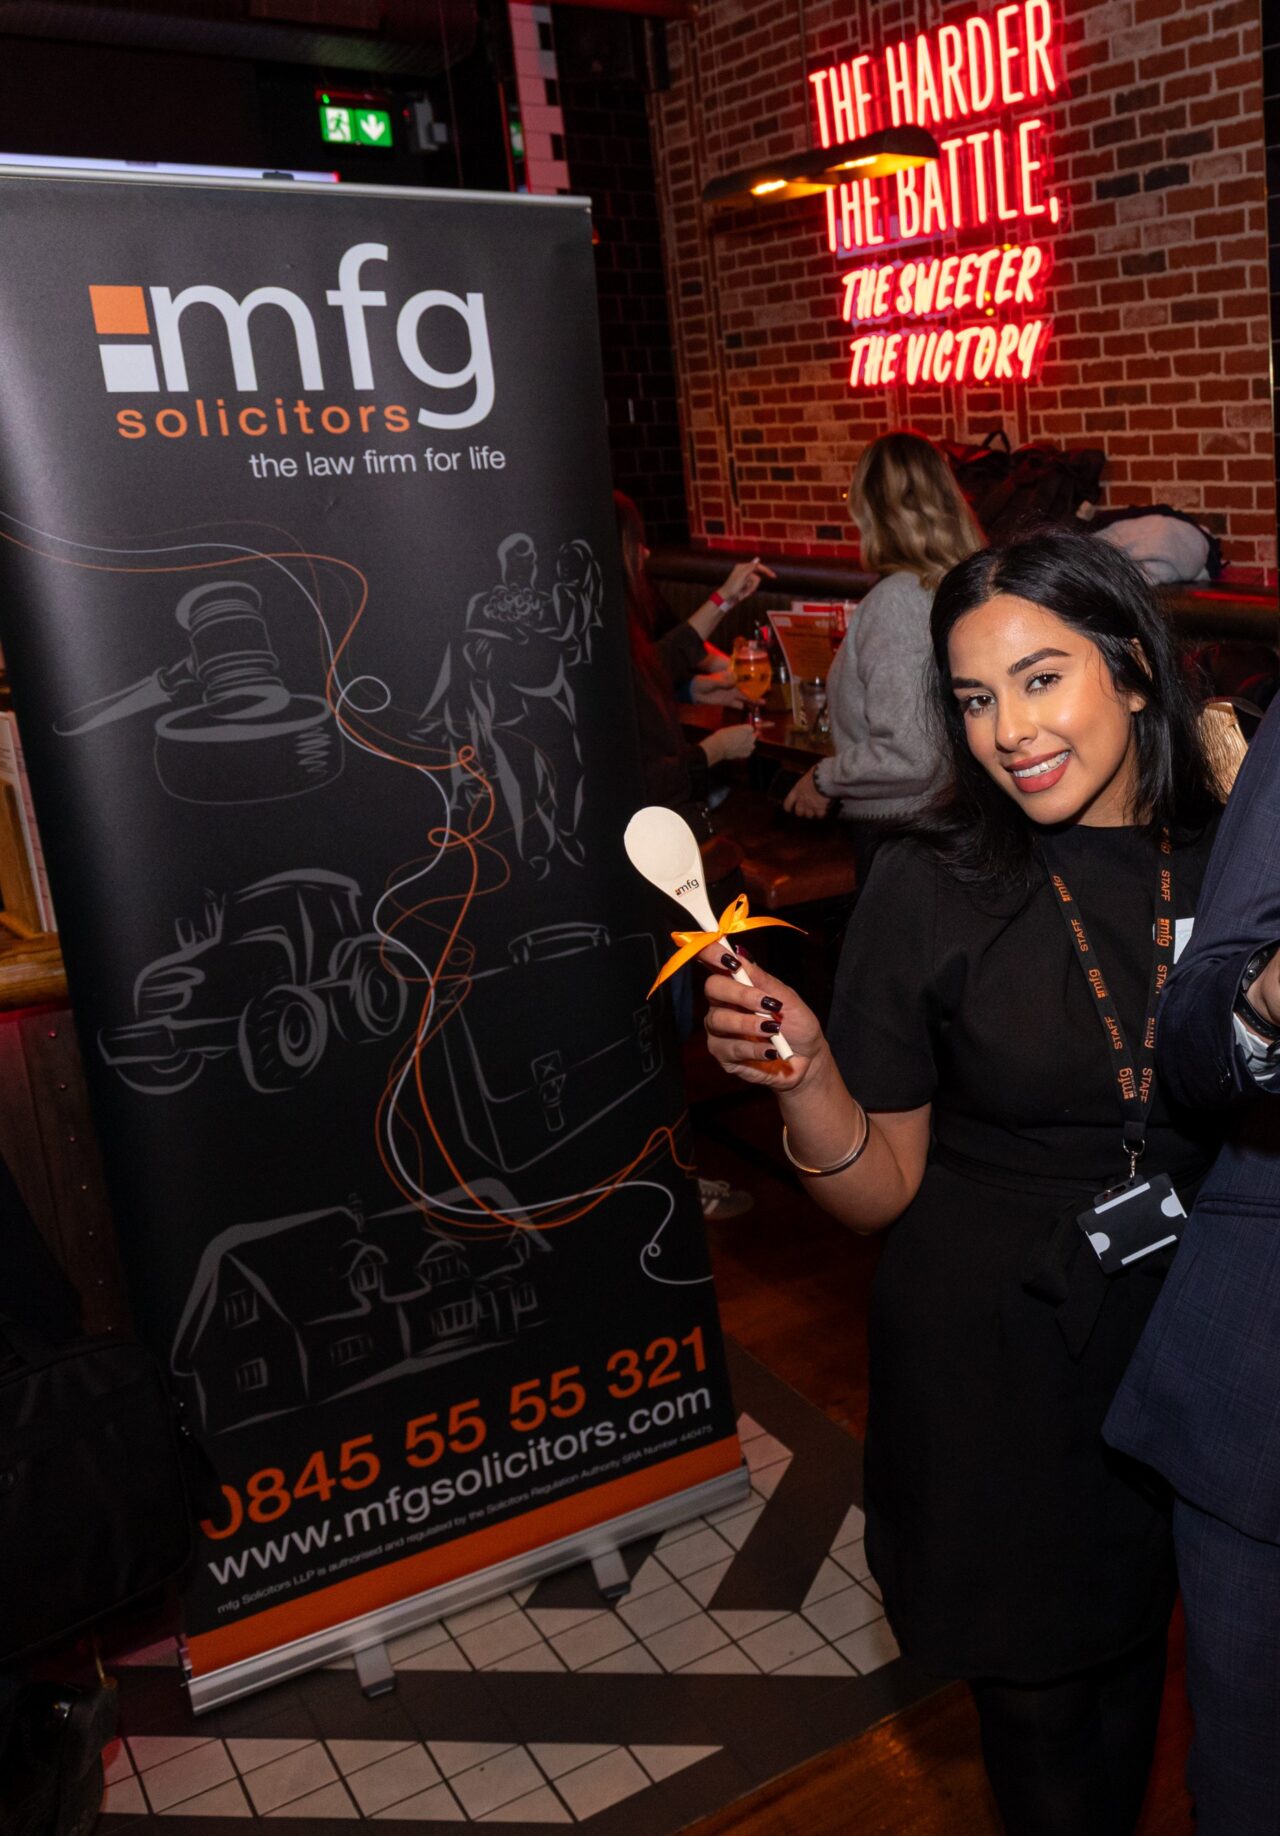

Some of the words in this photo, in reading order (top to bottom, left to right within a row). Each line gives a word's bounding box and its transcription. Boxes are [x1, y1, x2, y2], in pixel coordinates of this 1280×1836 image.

[885, 0, 1056, 127] HARDER
[826, 178, 884, 252] THE
[896, 119, 1059, 239] BATTLE,
[842, 265, 894, 322] THE
[896, 246, 1042, 316] SWEETER
[149, 242, 496, 430] mfg
[850, 333, 902, 387] THE
[906, 320, 1042, 386] VICTORY
[116, 398, 410, 440] solicitors
[249, 452, 298, 478] the
[306, 451, 355, 477] law
[363, 449, 416, 474] firm
[424, 446, 462, 472] for
[469, 445, 506, 471] life
[679, 879, 700, 893] mfg
[1160, 869, 1172, 903] STAFF
[1070, 919, 1089, 952] STAFF
[1157, 919, 1173, 948] mfg
[1088, 968, 1105, 996] mfg
[1104, 1016, 1123, 1050] STAFF
[1116, 1067, 1134, 1098] mfg
[1139, 1067, 1153, 1103] STAFF
[199, 1435, 380, 1541] 0845
[404, 1397, 487, 1468] 55
[509, 1365, 587, 1431] 55
[606, 1326, 706, 1399] 321
[208, 1387, 711, 1585] www.mfgsolicitors.com
[217, 1599, 240, 1614] mfg
[241, 1578, 292, 1605] Solicitors
[293, 1569, 316, 1586] LLP
[329, 1545, 383, 1572] authorised
[384, 1538, 404, 1552] and
[406, 1520, 452, 1545] regulated
[453, 1515, 467, 1528] by
[468, 1508, 485, 1520] the
[486, 1491, 529, 1514] Solicitors
[531, 1473, 579, 1497] Regulation
[580, 1457, 621, 1480] Authority
[644, 1437, 679, 1456] Number
